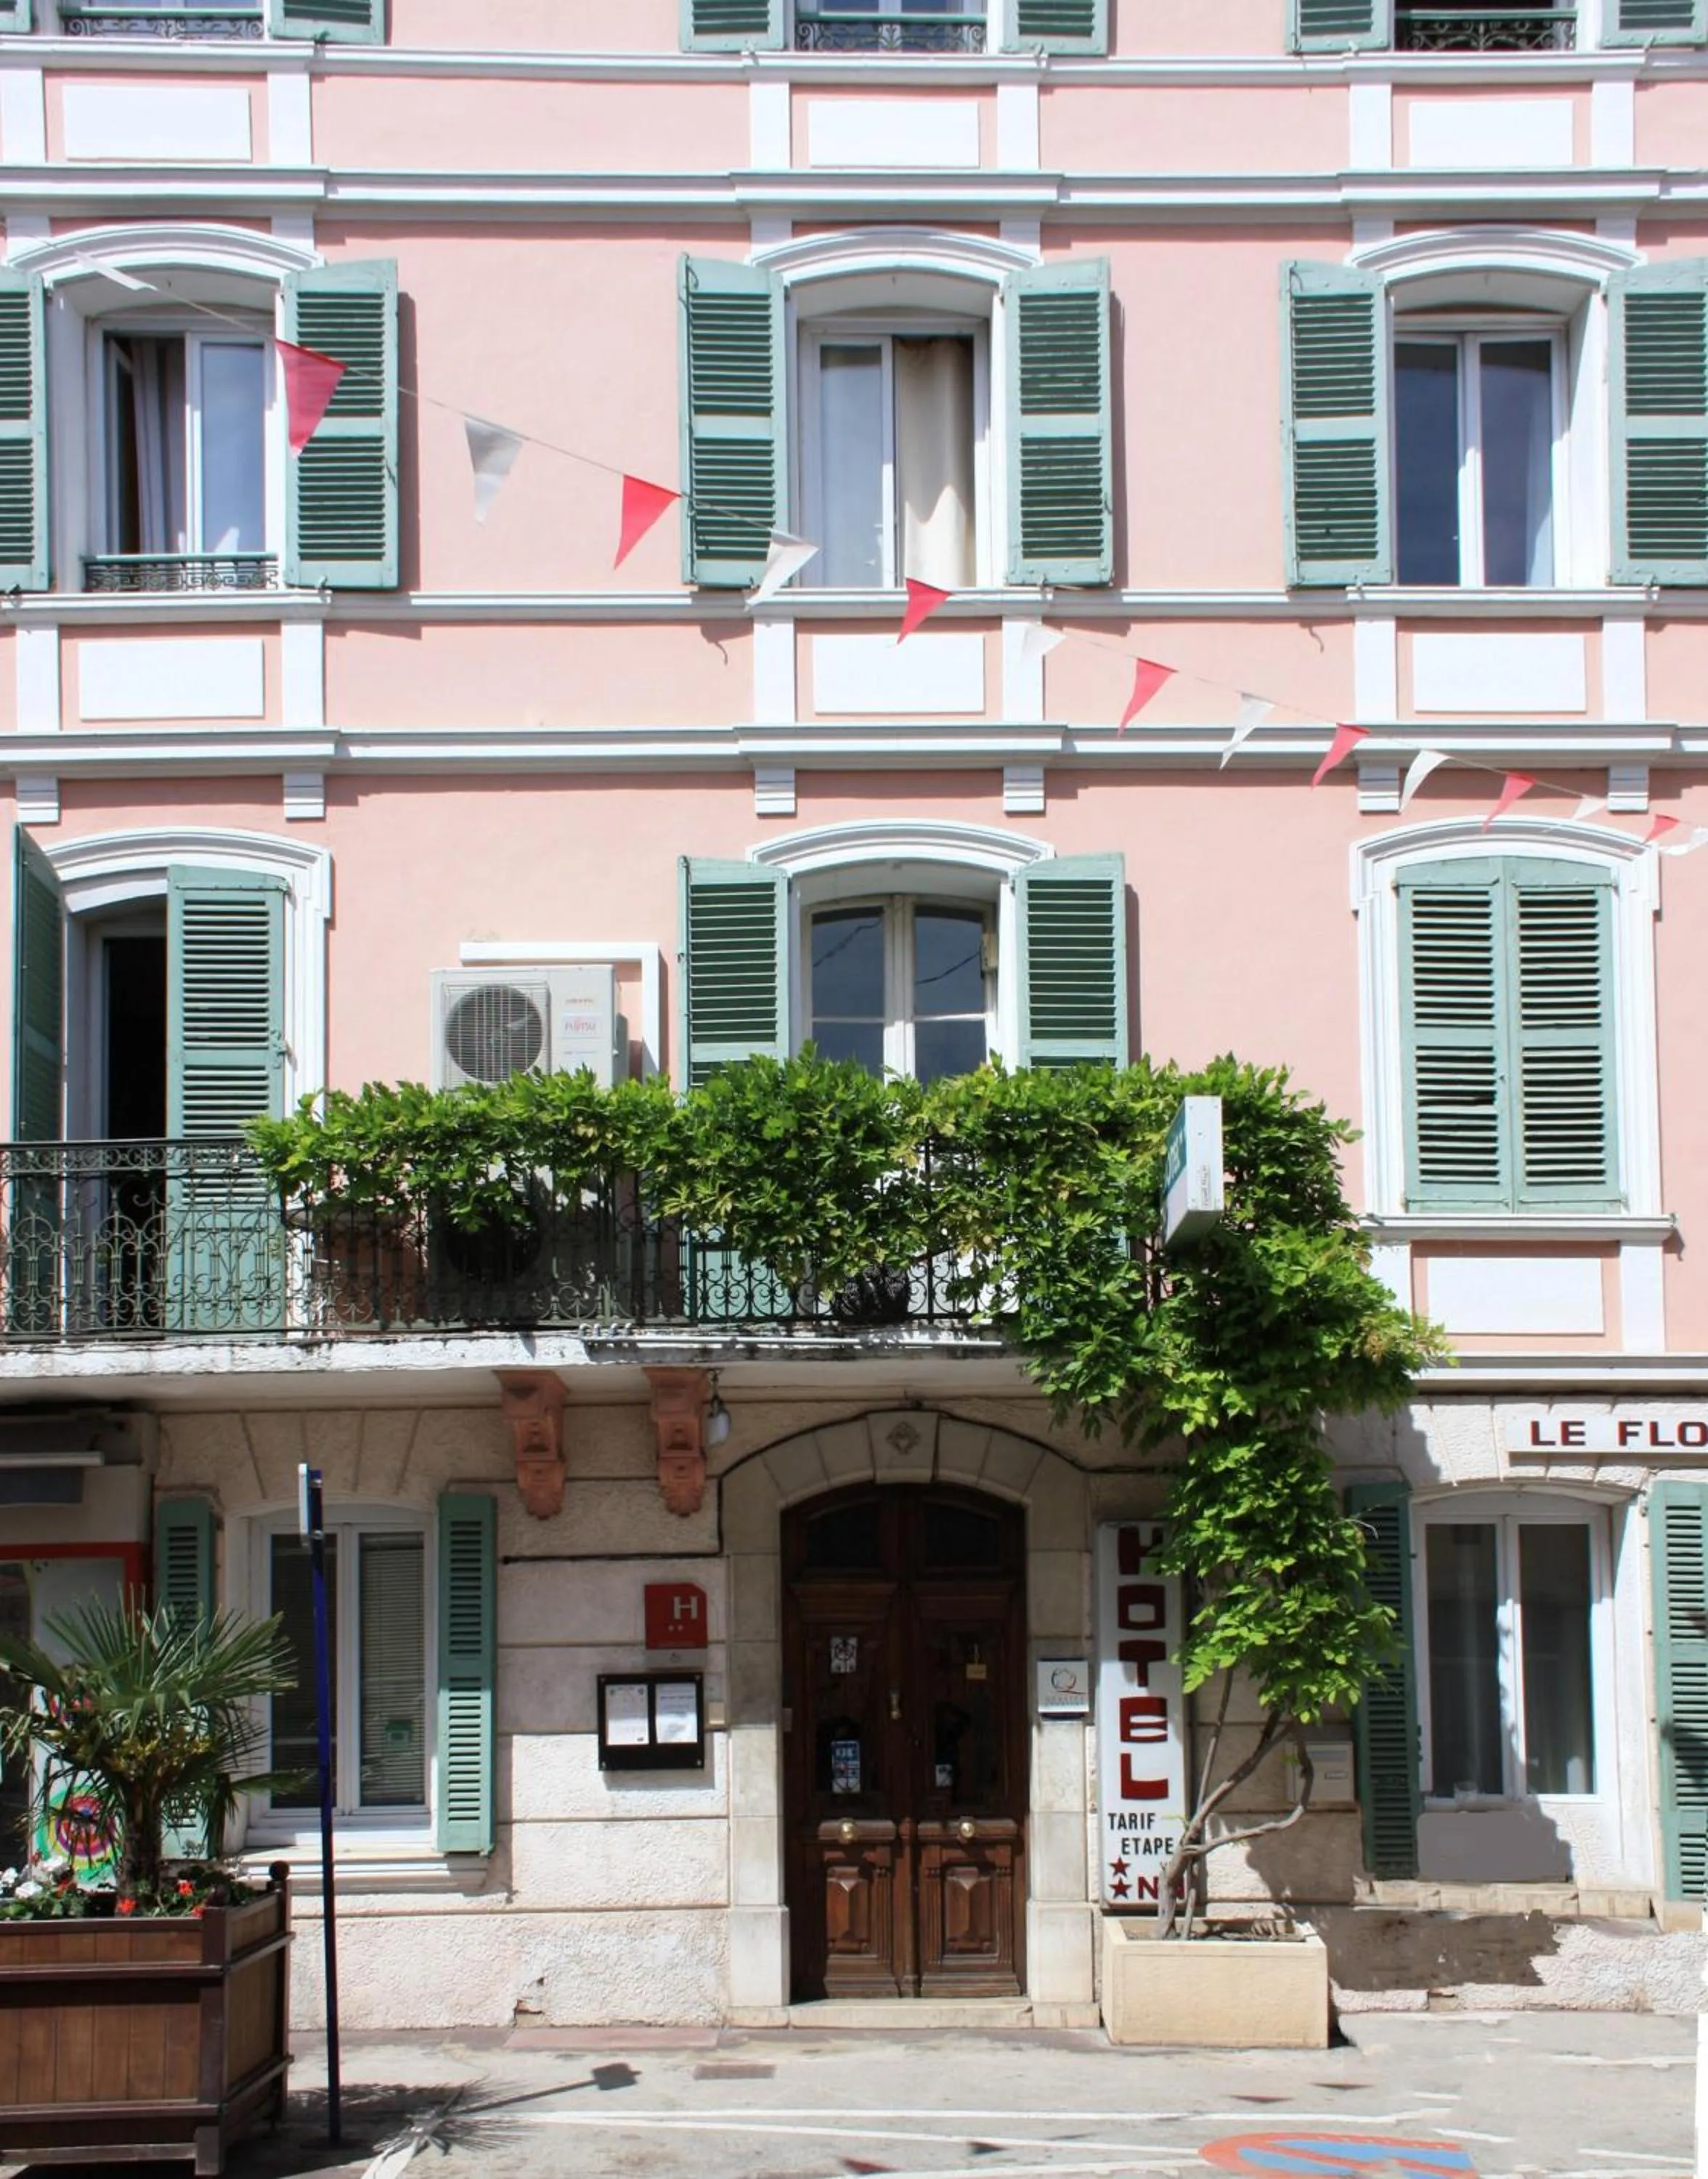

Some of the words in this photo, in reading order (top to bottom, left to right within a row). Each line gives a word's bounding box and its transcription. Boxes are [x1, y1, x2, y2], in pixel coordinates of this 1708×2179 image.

[1531, 1420, 1586, 1446] LE
[1619, 1420, 1708, 1447] FLO
[673, 1596, 698, 1620] H
[1117, 1526, 1168, 1800] HOTEL
[1107, 1812, 1156, 1830] TARIF
[1121, 1837, 1174, 1855] ETAPE
